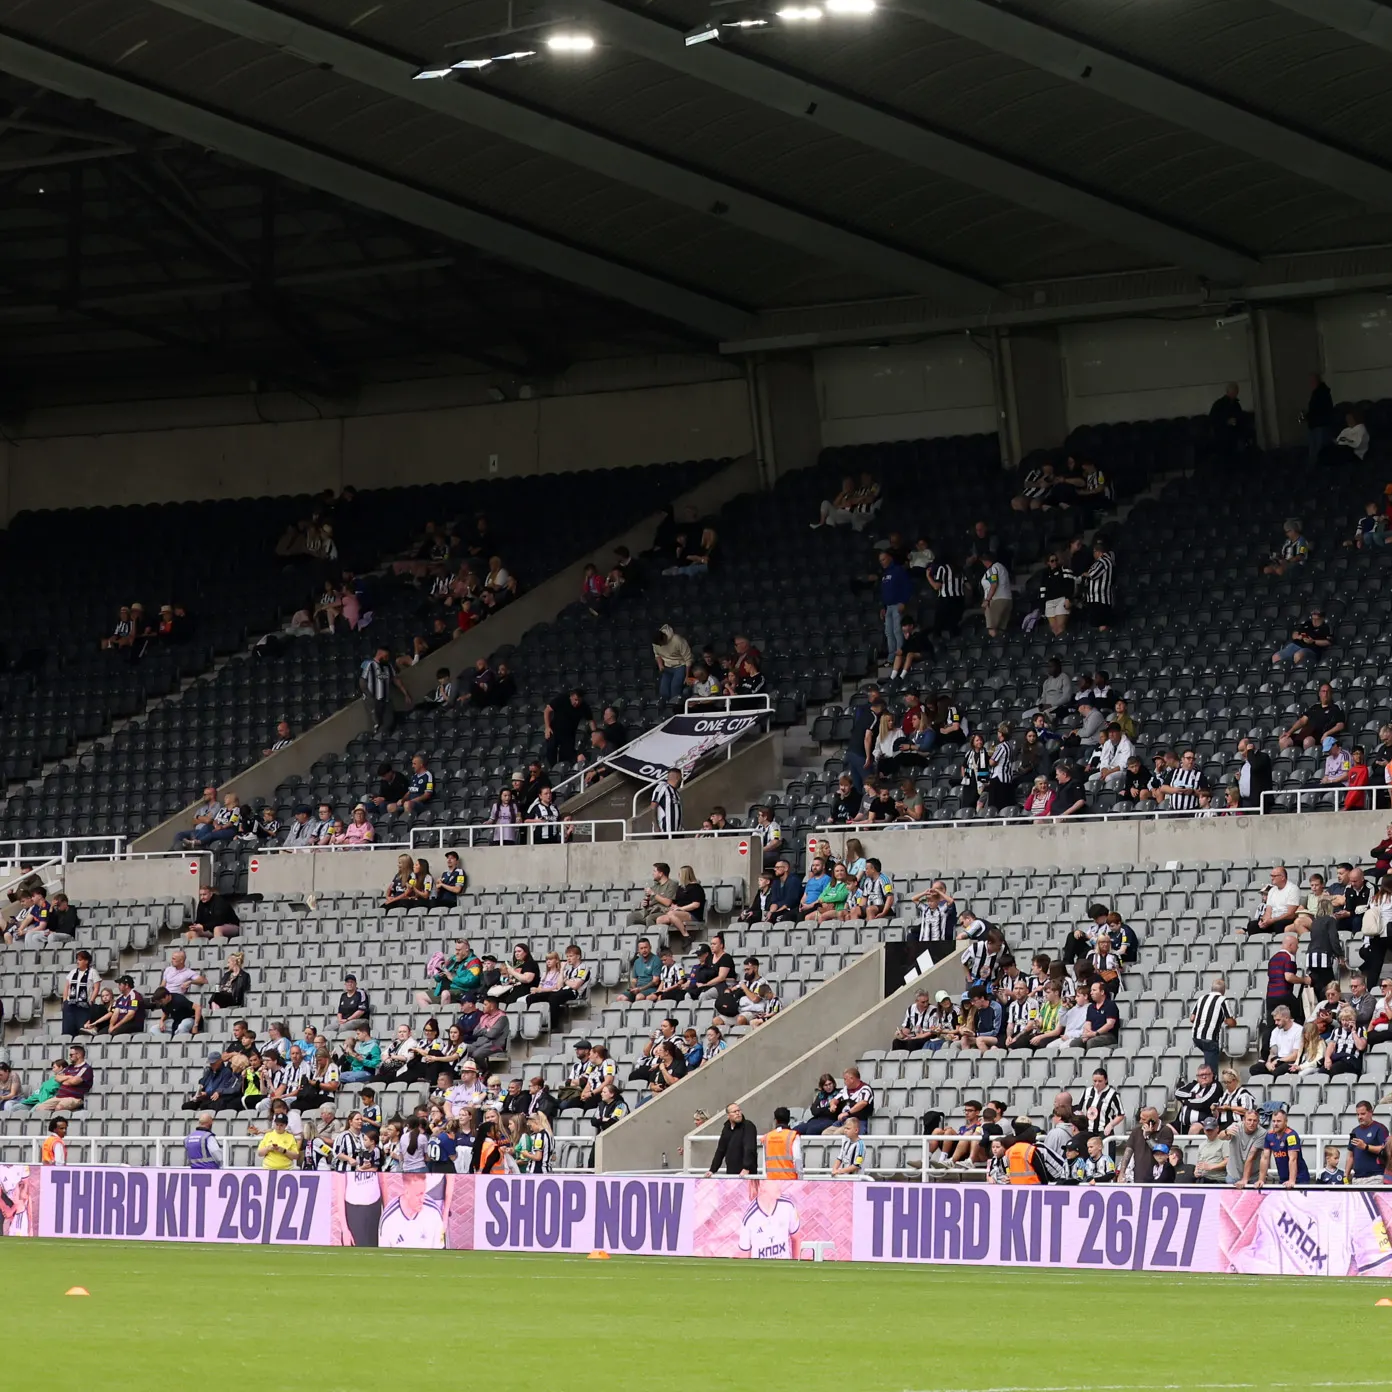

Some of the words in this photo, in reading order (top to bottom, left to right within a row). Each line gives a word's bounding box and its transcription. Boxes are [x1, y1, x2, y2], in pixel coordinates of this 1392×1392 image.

[694, 718, 726, 733] ONE
[638, 764, 668, 779] ON
[51, 1170, 149, 1236] THIRD
[156, 1172, 212, 1239] KIT
[217, 1169, 321, 1245] 26/27
[485, 1177, 587, 1250] SHOP
[594, 1180, 685, 1251] NOW
[866, 1186, 991, 1260] THIRD
[1000, 1189, 1070, 1263] KIT
[1076, 1186, 1206, 1270] 26/27
[1277, 1210, 1328, 1269] KNOX
